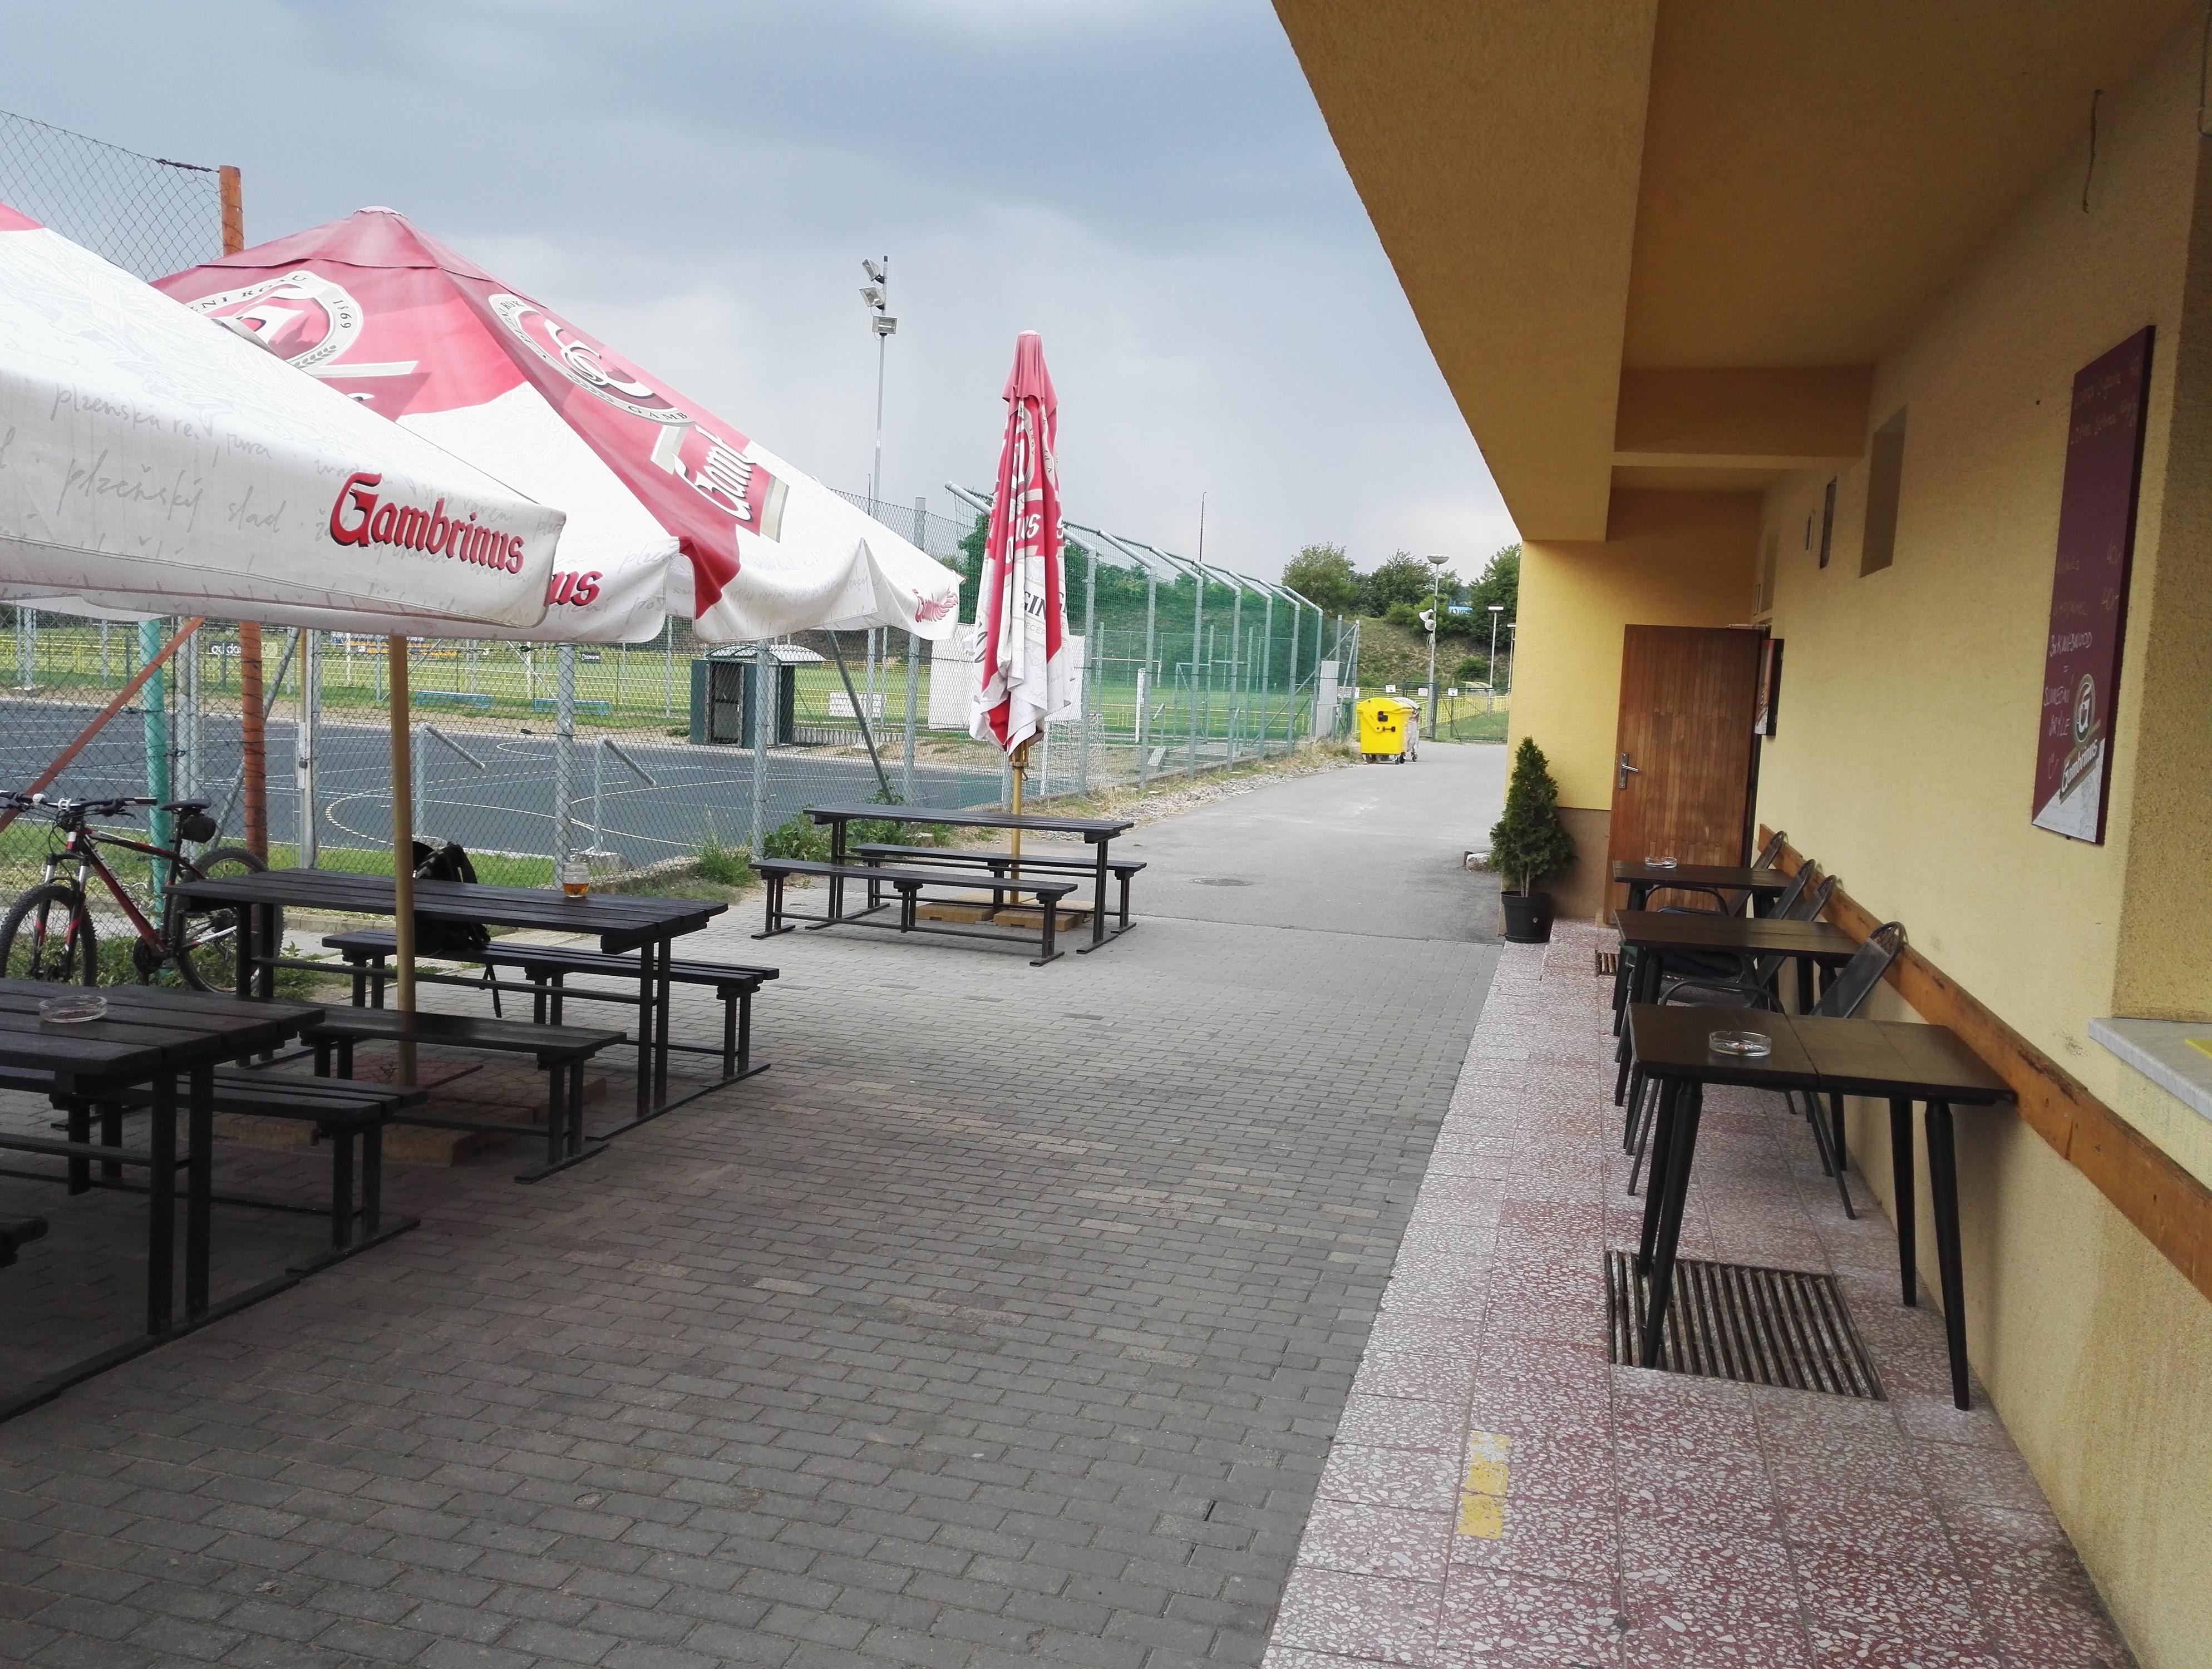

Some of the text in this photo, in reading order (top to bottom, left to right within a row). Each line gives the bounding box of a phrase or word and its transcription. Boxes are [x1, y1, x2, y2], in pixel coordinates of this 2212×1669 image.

[332, 299, 352, 329] 1869
[627, 404, 688, 420] GAMB
[329, 472, 525, 574] Gambrinus
[548, 570, 603, 607] us
[2061, 738, 2098, 793] Gambrinus
